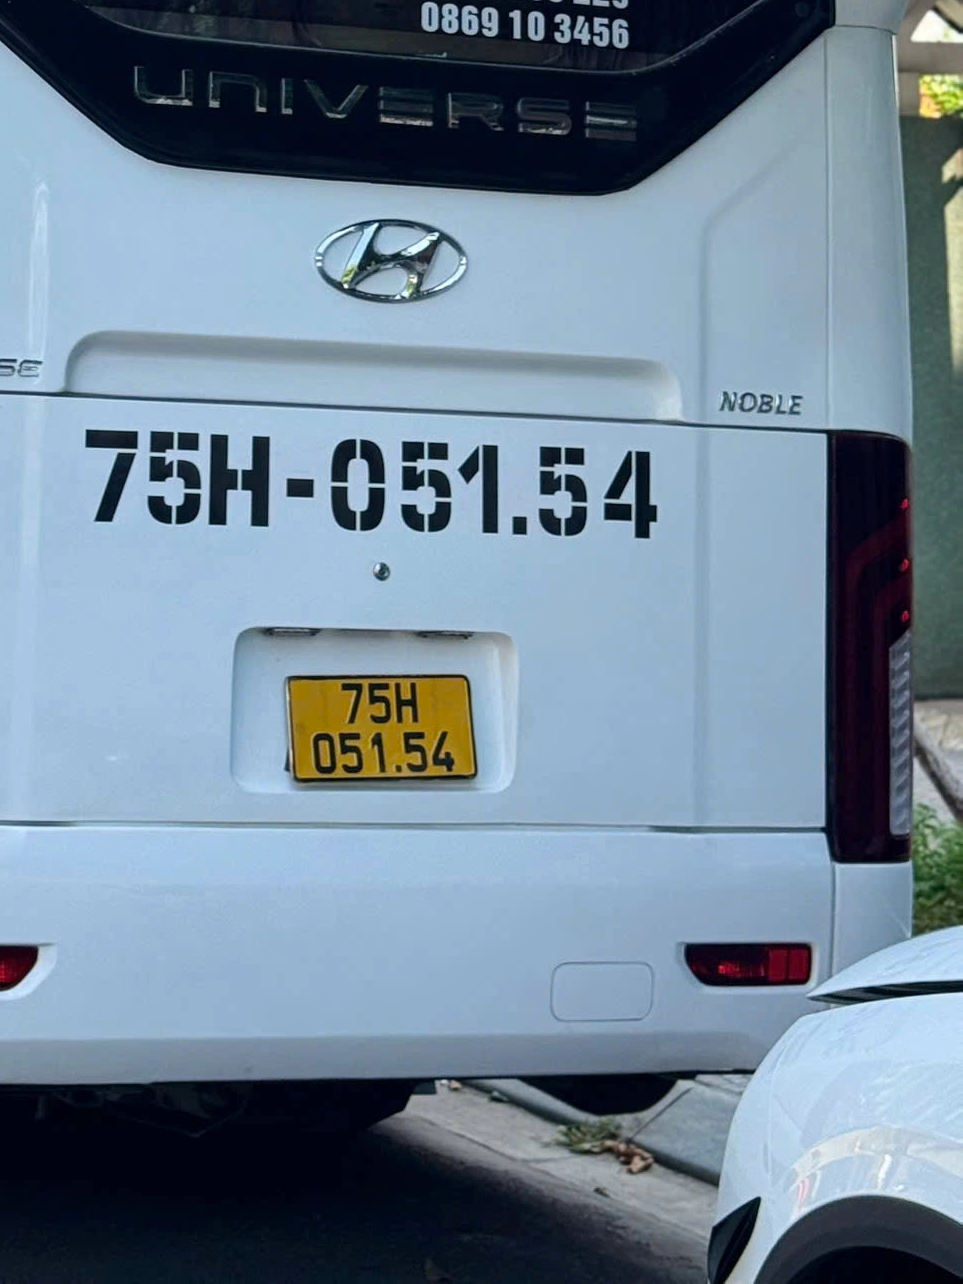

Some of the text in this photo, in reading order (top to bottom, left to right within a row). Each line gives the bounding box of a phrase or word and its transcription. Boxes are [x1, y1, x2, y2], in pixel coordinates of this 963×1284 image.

[421, 1, 629, 50] 0869 10 3456
[134, 65, 637, 142] UNIVERSE
[719, 391, 804, 415] NOBLE
[85, 429, 659, 540] 75H-051.54
[341, 682, 418, 724] 75H
[313, 731, 455, 774] 051.54
